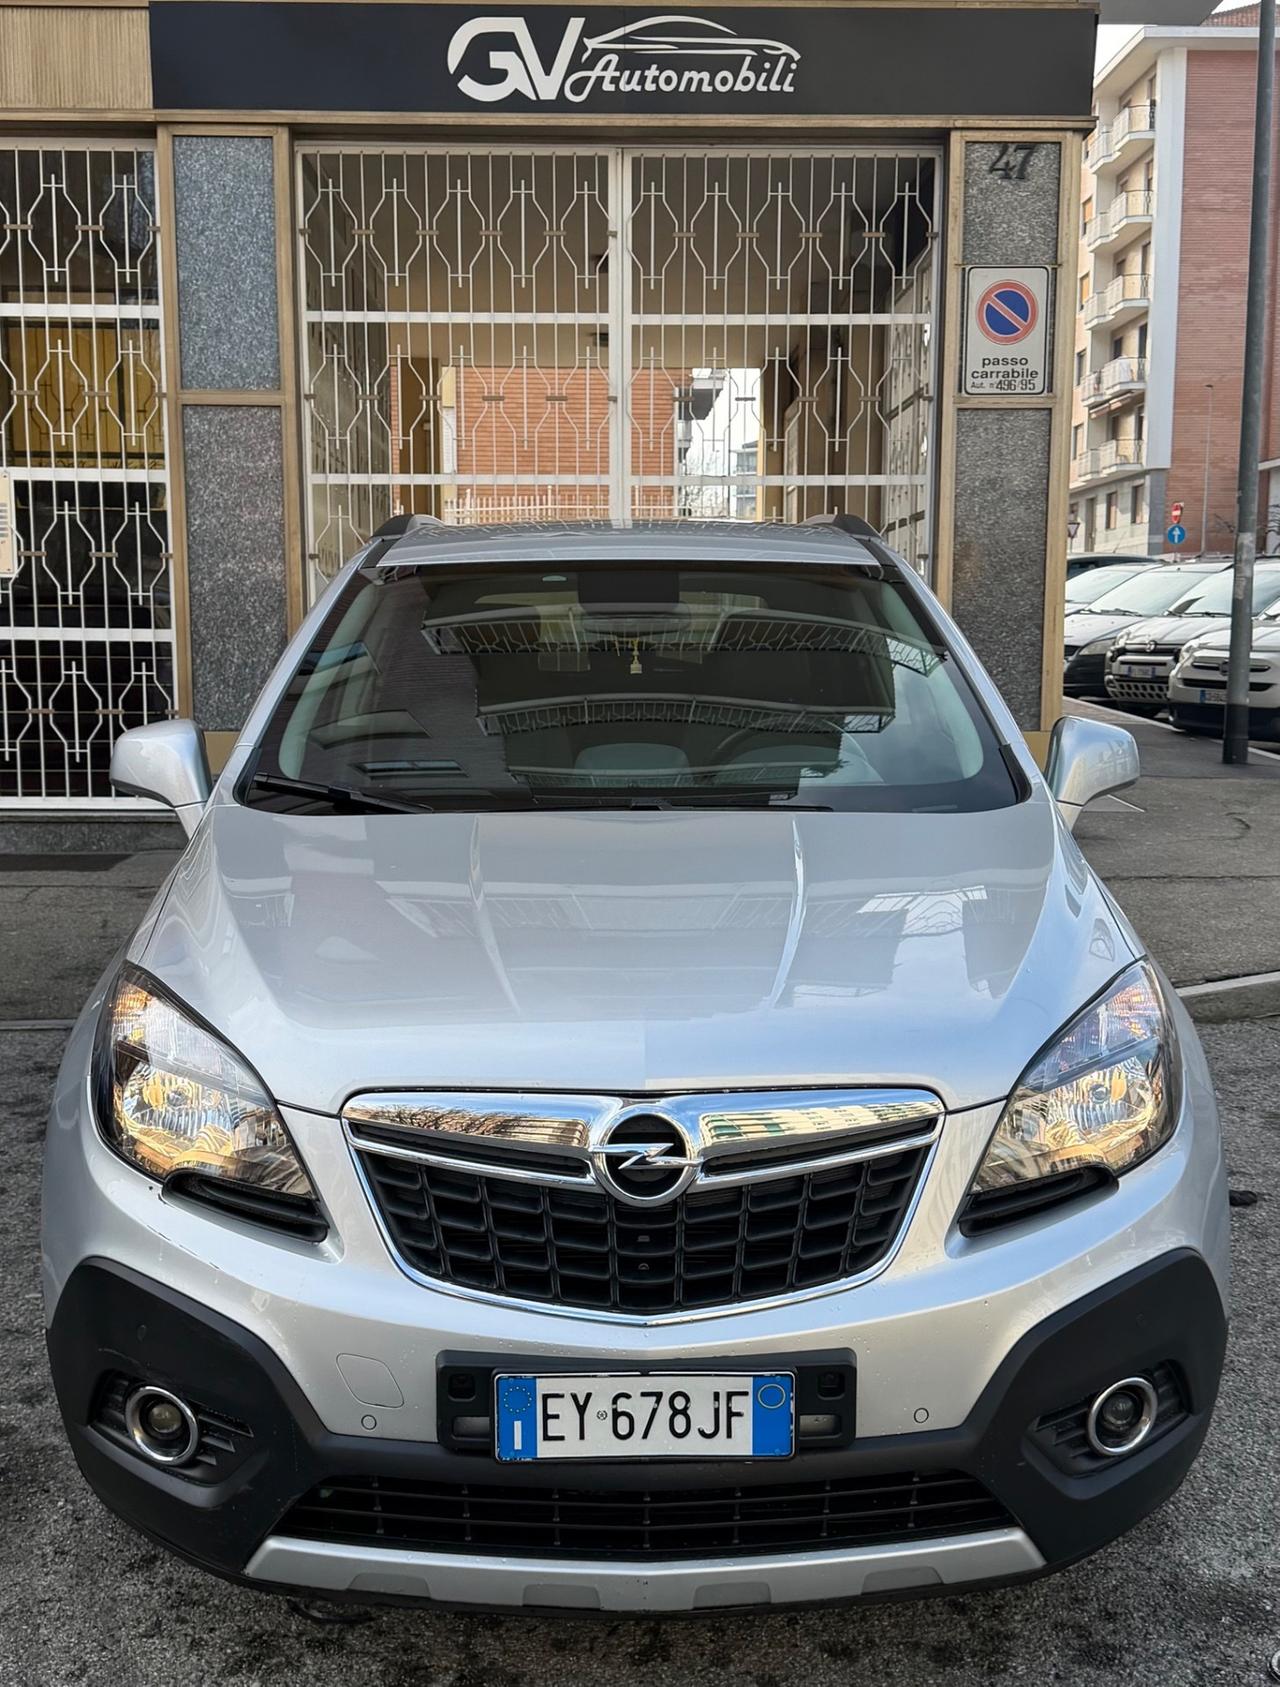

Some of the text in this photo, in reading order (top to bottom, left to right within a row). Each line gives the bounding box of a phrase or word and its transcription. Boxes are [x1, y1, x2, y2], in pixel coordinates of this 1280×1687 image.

[447, 16, 796, 103] GV Automobili
[989, 143, 1037, 180] 47
[971, 368, 1039, 379] carrabile
[982, 357, 1029, 369] passo
[541, 1392, 593, 1441] EY
